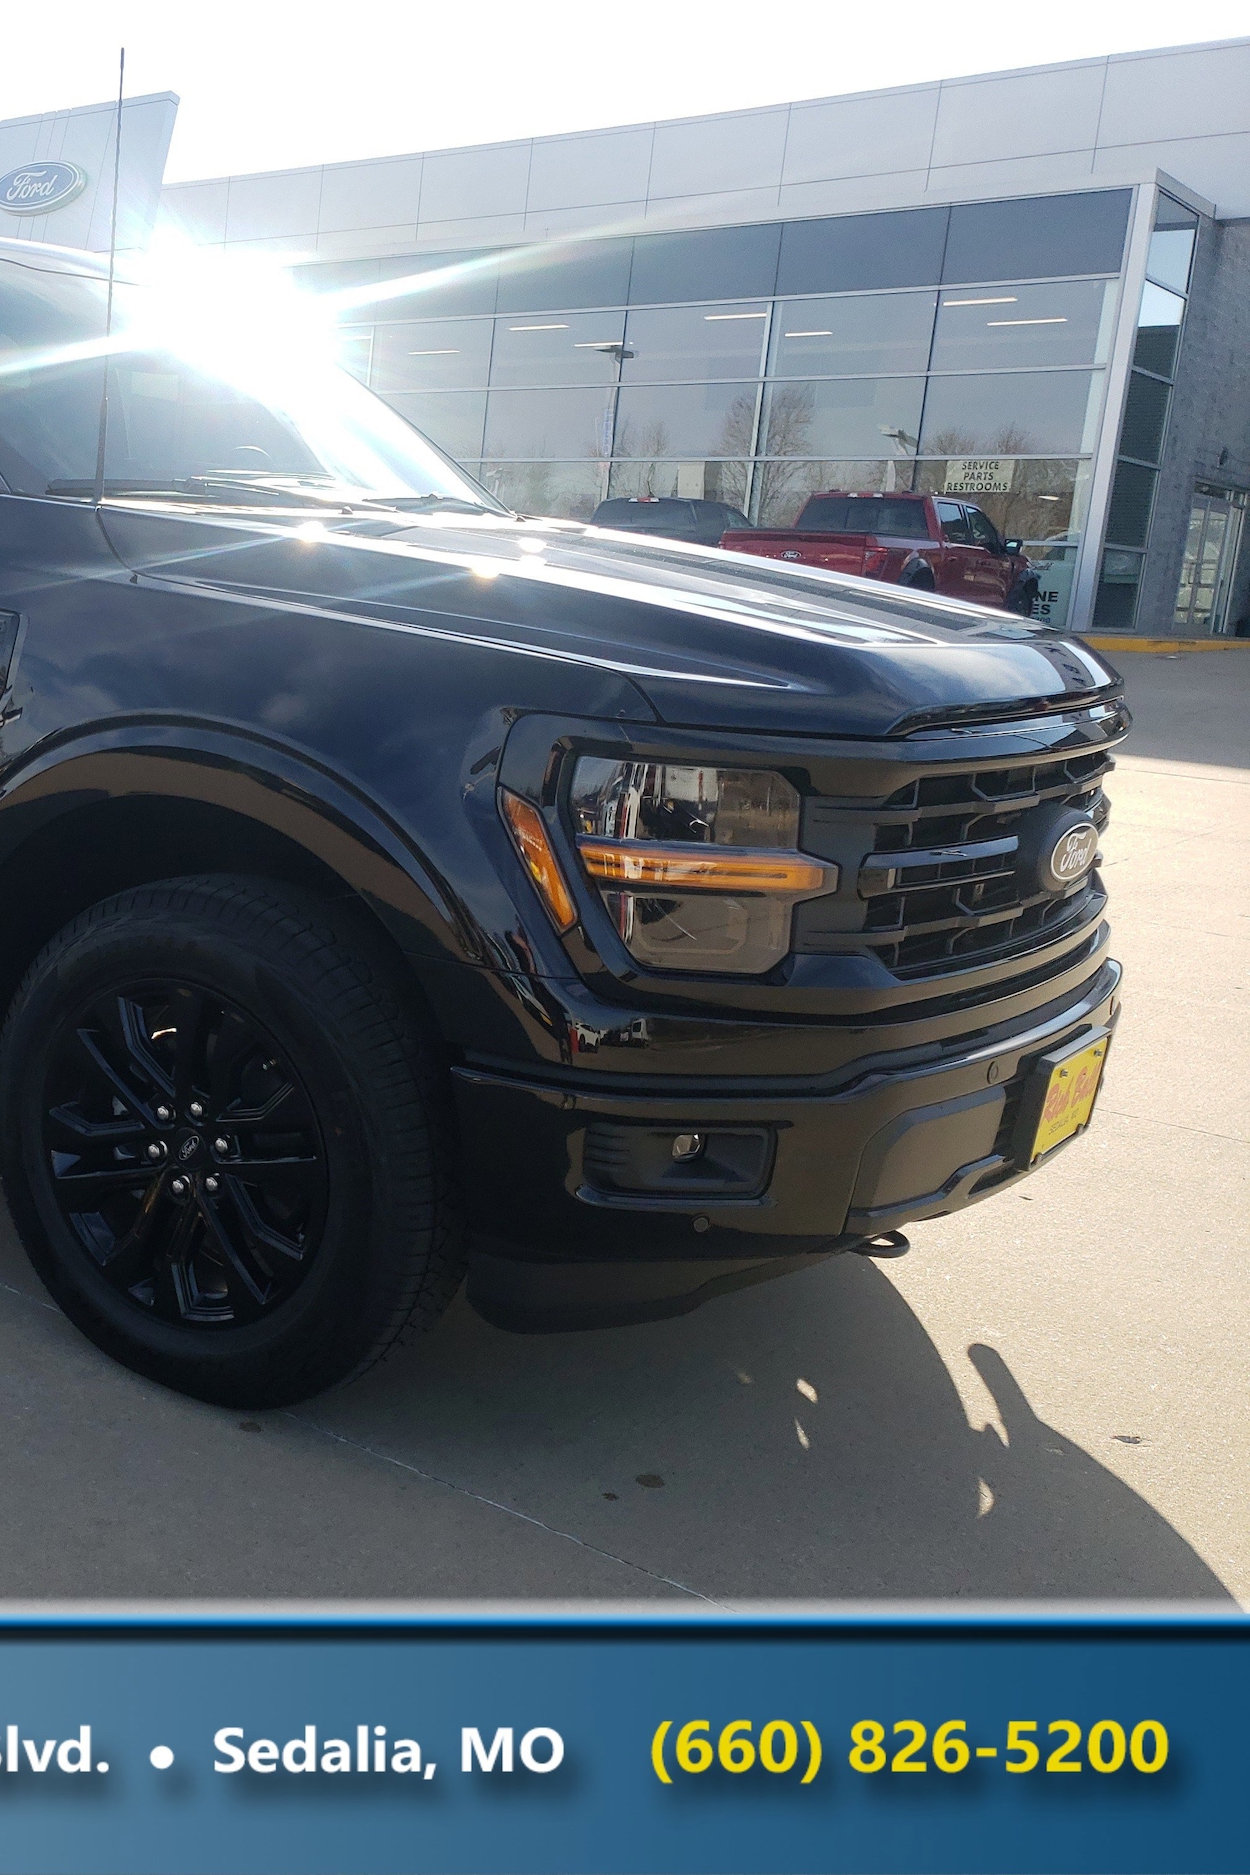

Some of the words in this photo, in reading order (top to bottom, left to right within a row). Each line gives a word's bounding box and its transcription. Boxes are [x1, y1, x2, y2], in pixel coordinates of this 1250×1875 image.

[6, 170, 58, 201] Ford
[961, 461, 1000, 470] SERVICE
[963, 472, 994, 481] PARTS
[946, 482, 1009, 491] RESTROOMS
[1060, 832, 1093, 872] Ford
